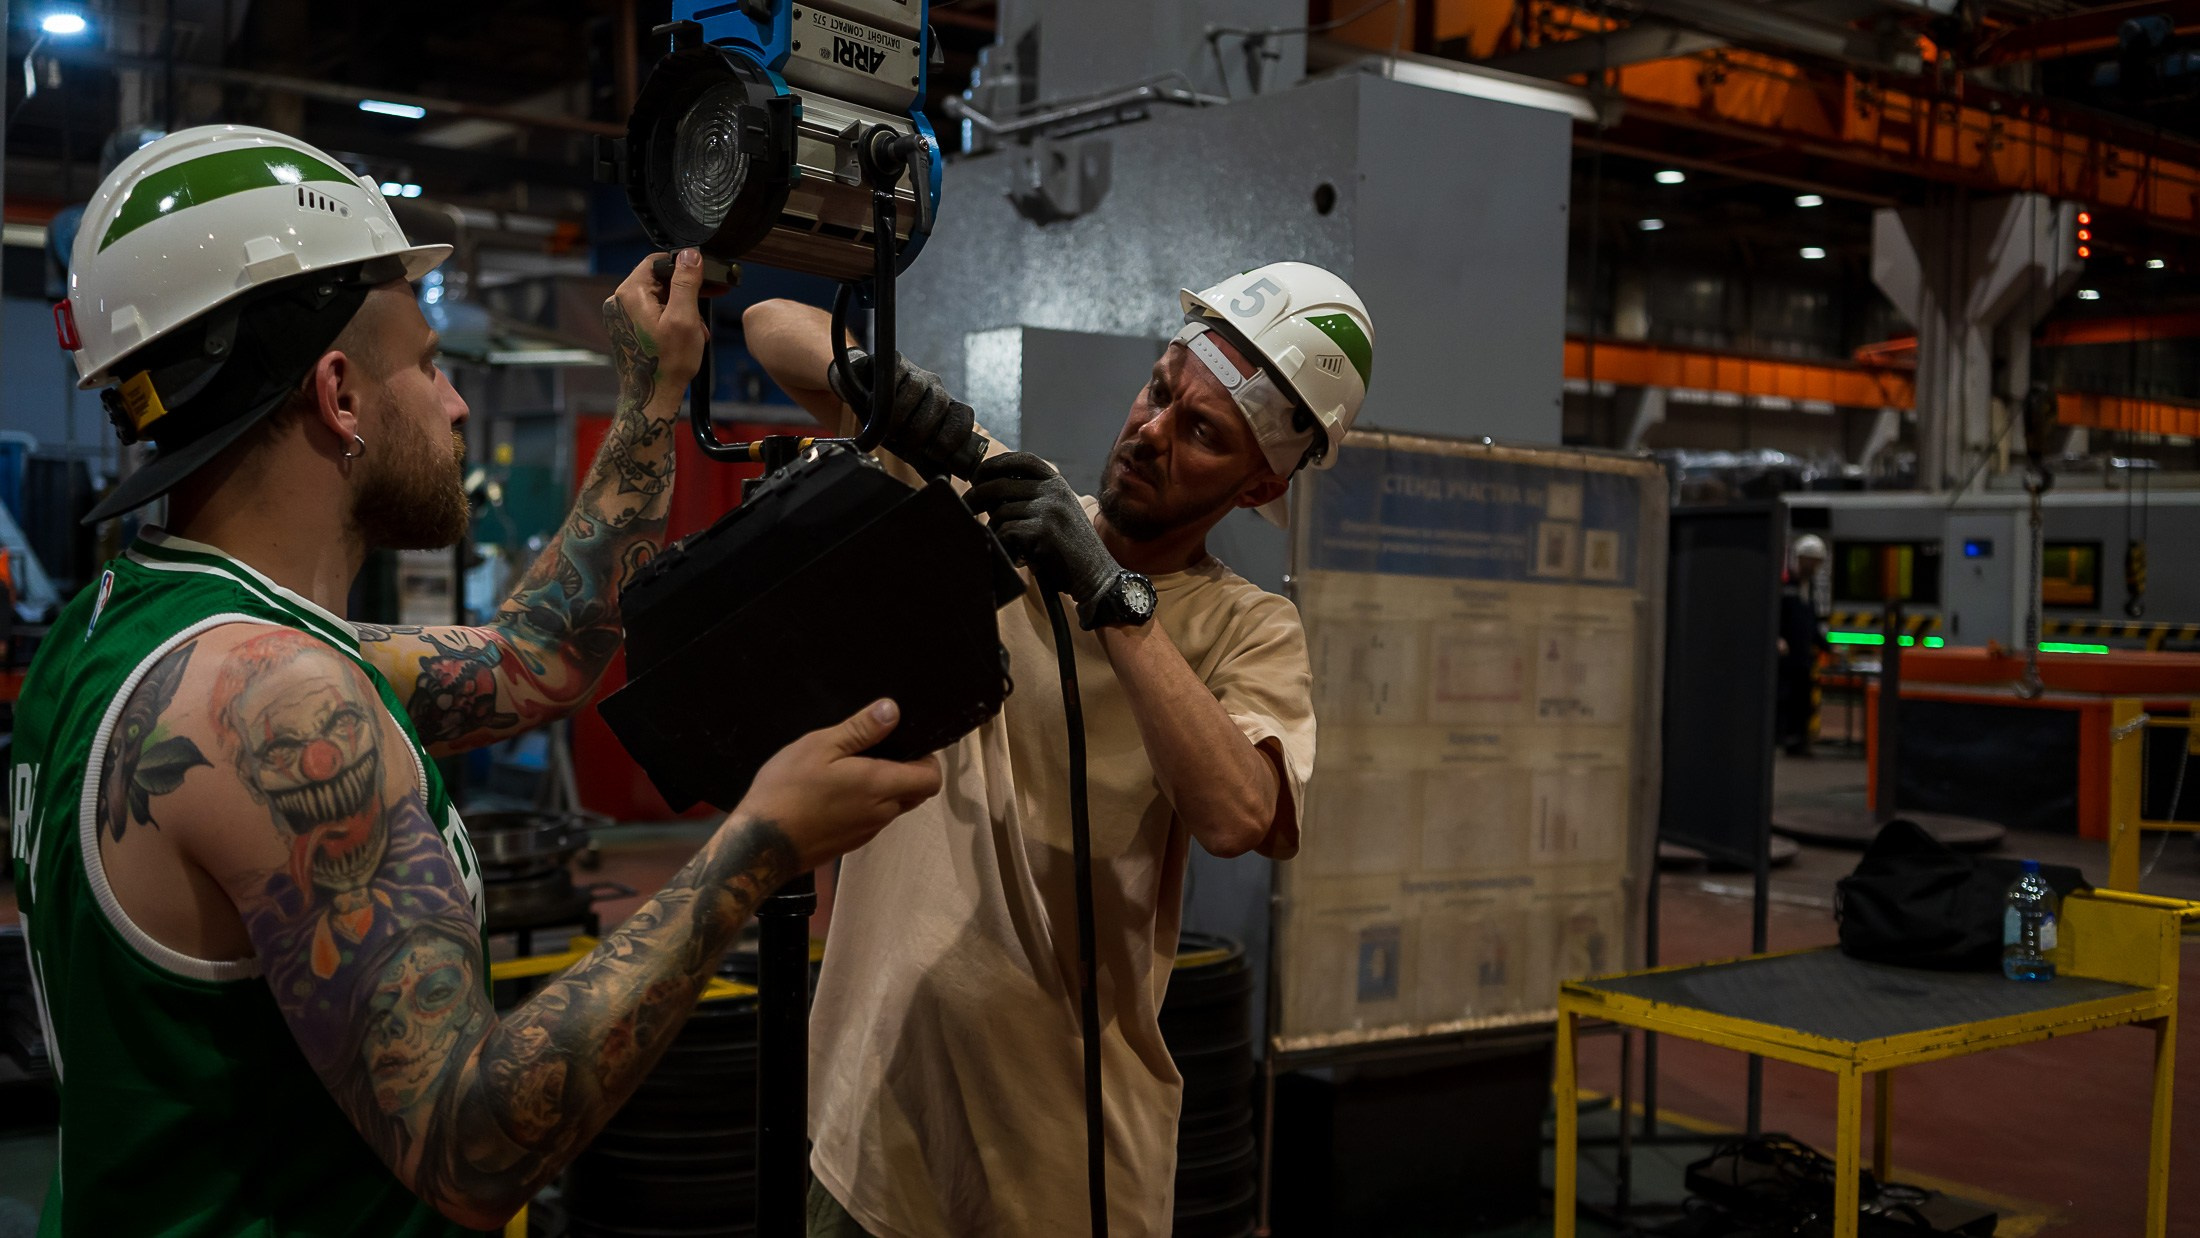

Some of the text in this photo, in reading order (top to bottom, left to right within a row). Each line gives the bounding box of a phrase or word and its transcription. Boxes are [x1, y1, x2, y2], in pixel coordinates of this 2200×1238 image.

[813, 13, 901, 49] DAYLIGHT COMPACT 575
[833, 35, 886, 75] ARRI
[1230, 278, 1281, 318] 5
